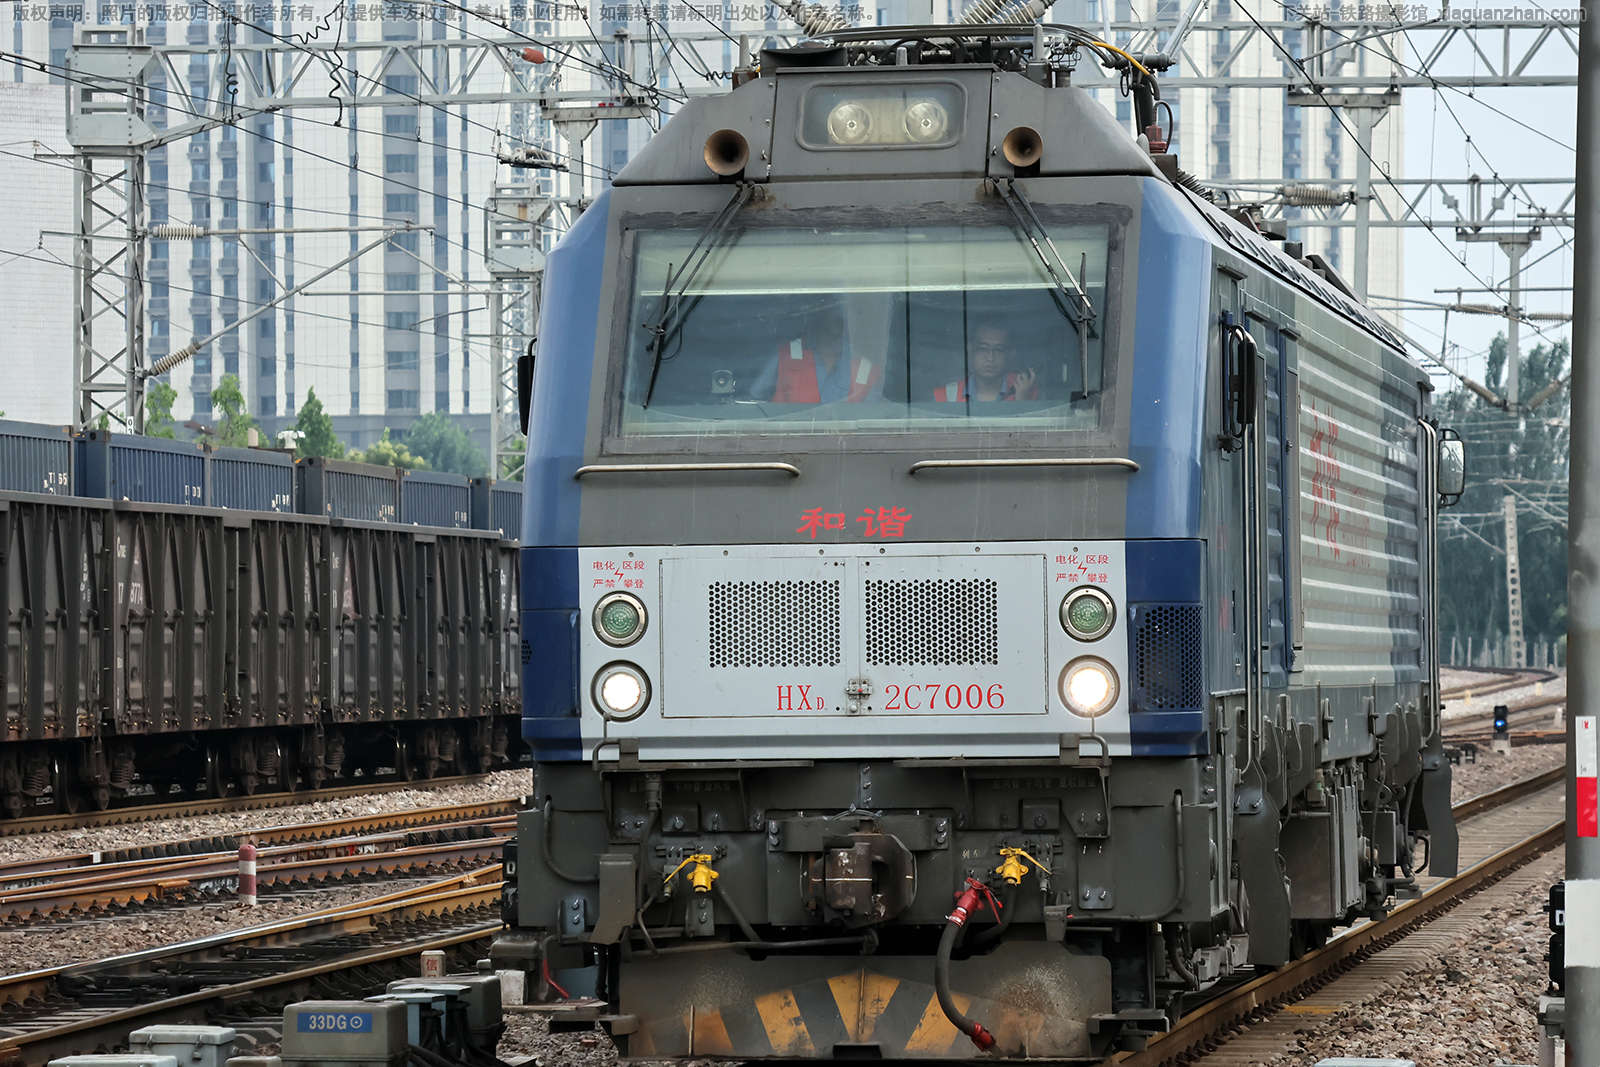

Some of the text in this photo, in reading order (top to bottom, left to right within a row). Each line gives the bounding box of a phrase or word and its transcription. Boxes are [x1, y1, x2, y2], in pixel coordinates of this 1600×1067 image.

[796, 505, 913, 539] 和谐
[884, 683, 1005, 710] 2C7006
[309, 1014, 347, 1030] 33DG
